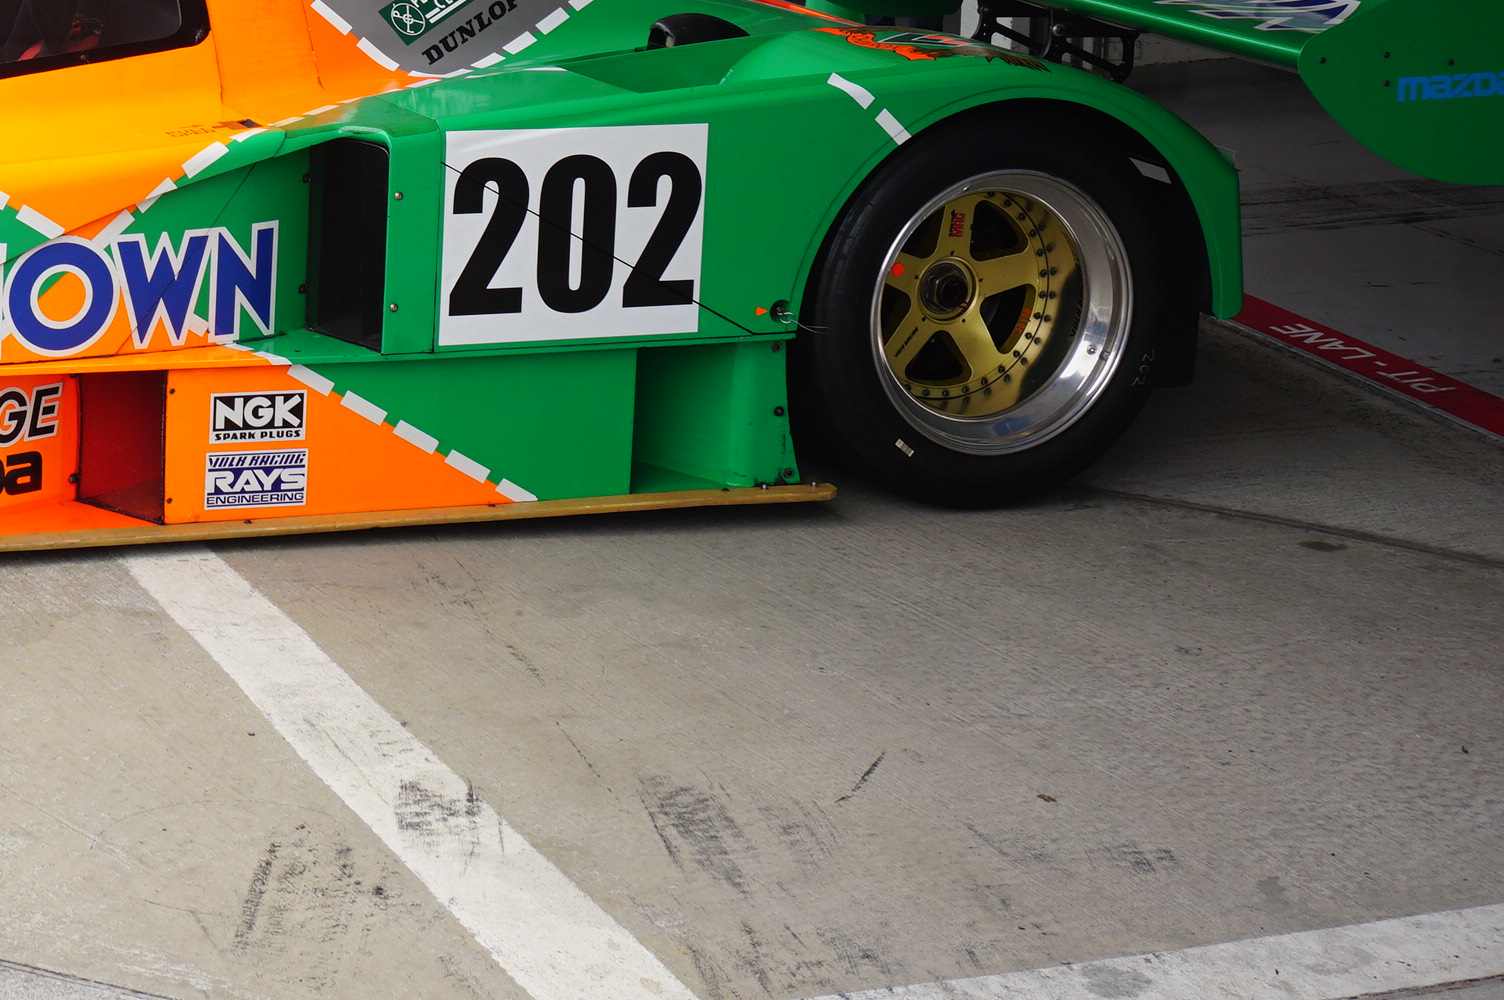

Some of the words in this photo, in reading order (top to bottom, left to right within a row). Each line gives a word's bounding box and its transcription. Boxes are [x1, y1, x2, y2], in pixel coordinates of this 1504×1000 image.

[448, 150, 703, 317] 202
[1269, 323, 1377, 360] LANE
[1376, 370, 1458, 393] PIT
[215, 394, 302, 429] NGK
[214, 431, 256, 441] SPARK
[260, 429, 301, 439] PLUGS
[249, 453, 306, 466] RACING
[207, 467, 305, 493] RAYS
[206, 492, 304, 505] ENGINEERING
